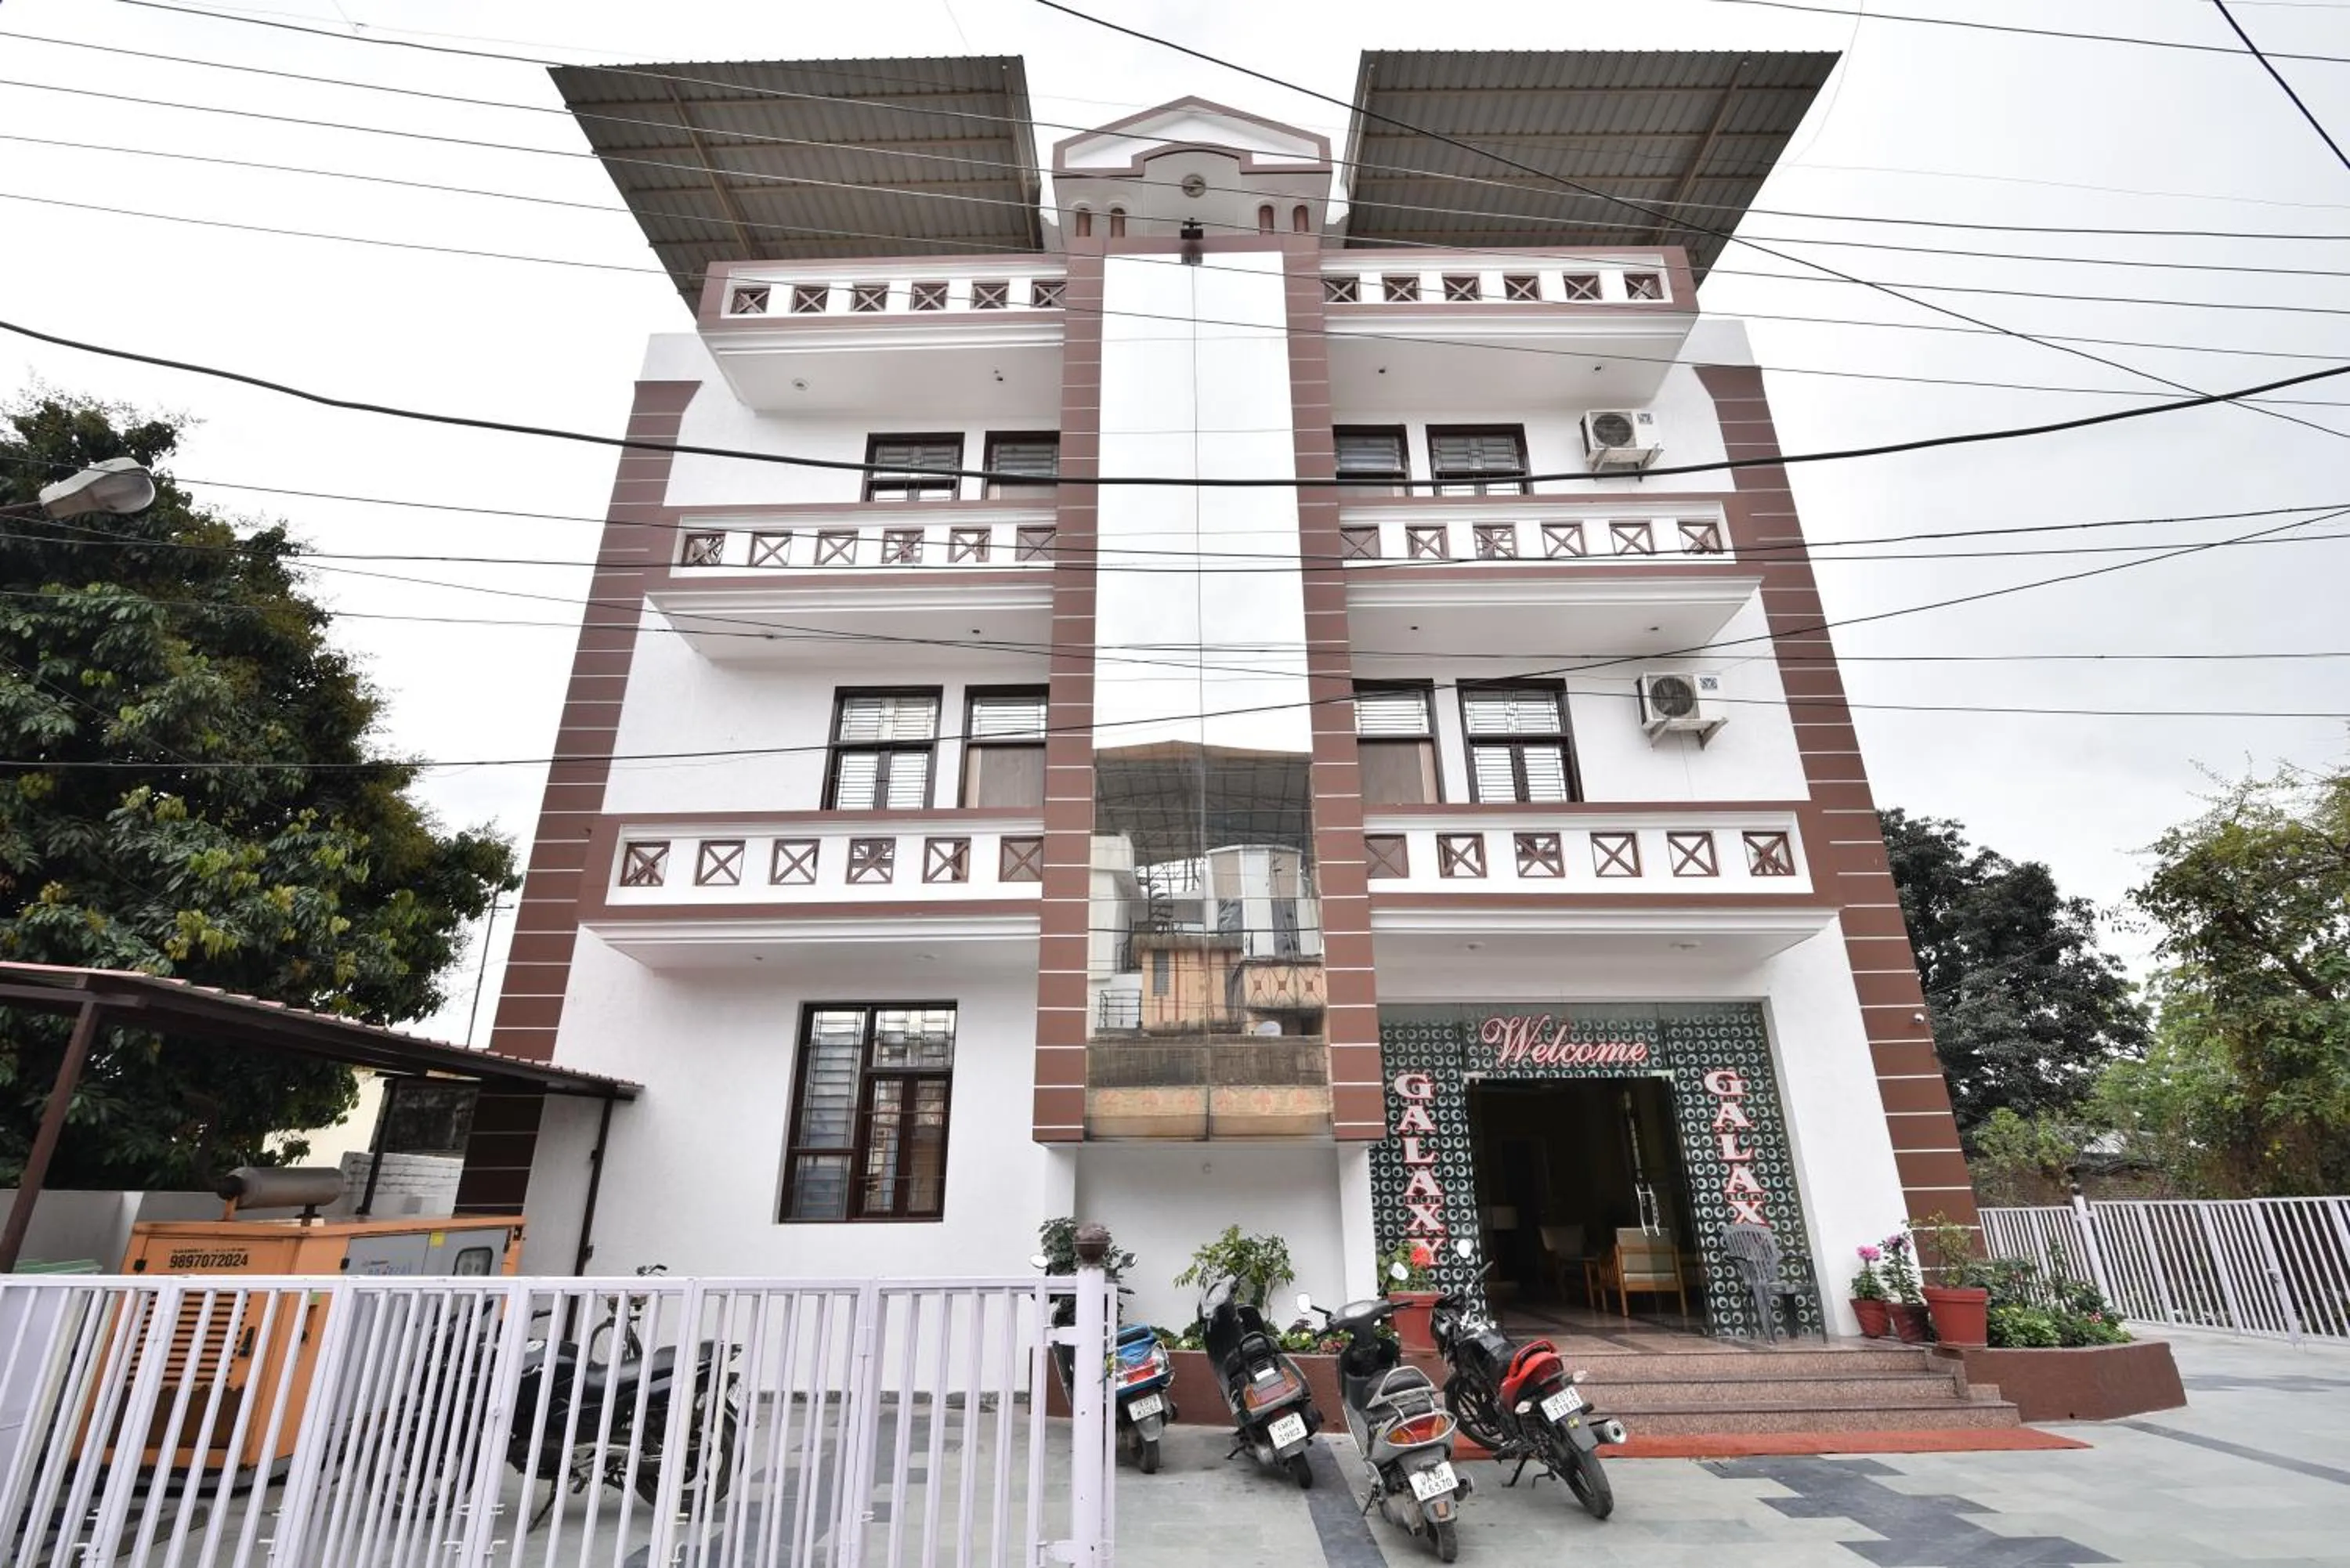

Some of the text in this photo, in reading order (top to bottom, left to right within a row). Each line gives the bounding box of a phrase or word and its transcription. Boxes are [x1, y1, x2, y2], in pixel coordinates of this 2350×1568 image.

[1480, 1013, 1648, 1064] Welcome
[1393, 1072, 1447, 1266] GALAXY
[1702, 1069, 1772, 1227] GALAX
[168, 1253, 249, 1268] 9897072024
